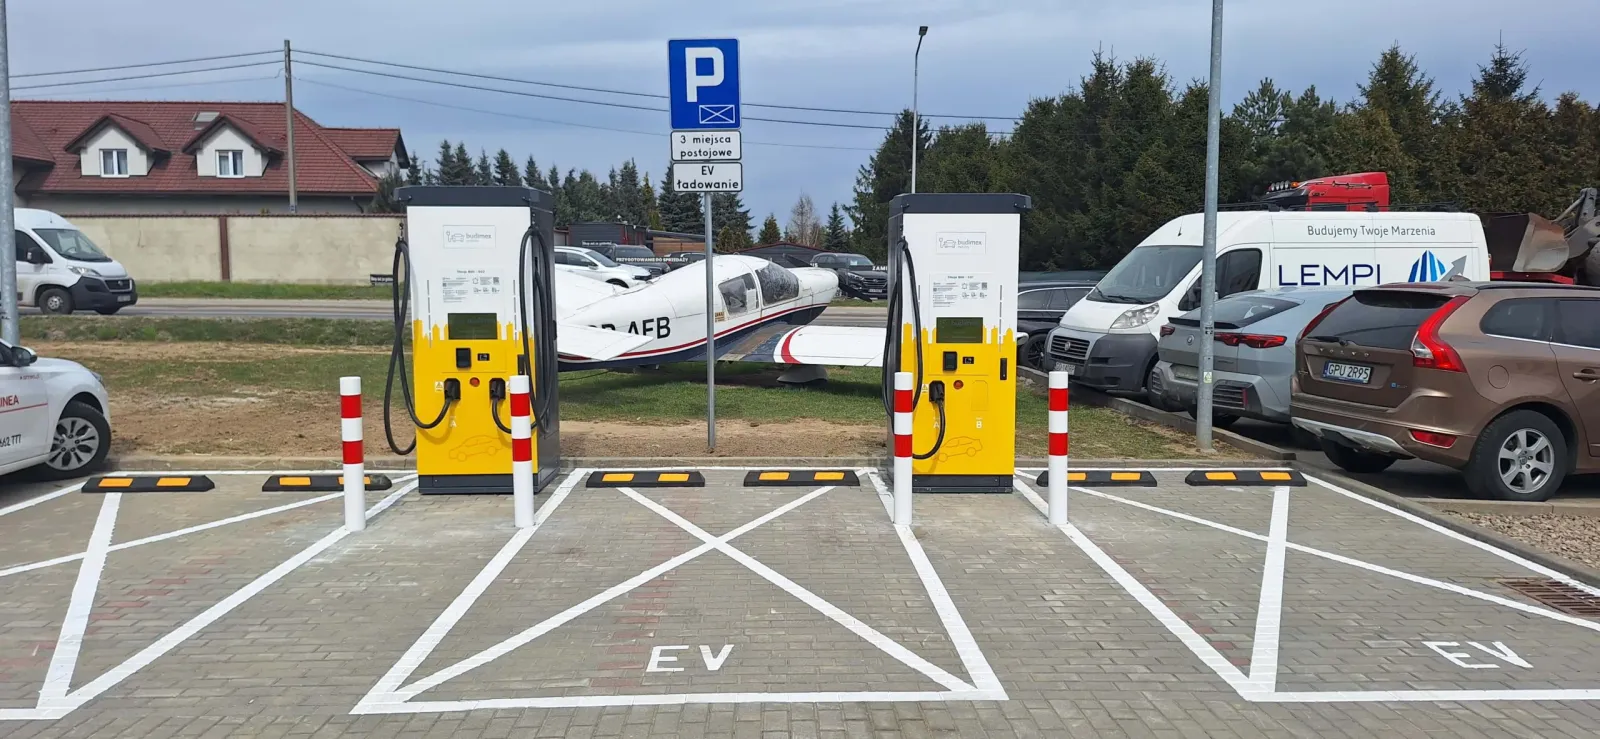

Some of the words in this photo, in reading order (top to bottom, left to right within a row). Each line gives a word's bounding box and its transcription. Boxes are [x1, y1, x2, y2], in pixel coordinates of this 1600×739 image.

[685, 46, 725, 103] P
[680, 135, 686, 144] 3
[692, 134, 731, 146] miejsca
[680, 148, 732, 160] postojowe
[701, 165, 715, 176] EV
[677, 179, 739, 189] ładowanie
[1307, 225, 1358, 239] Budujemy
[1360, 225, 1389, 238] Twoje
[1391, 225, 1436, 236] Marzenia
[1278, 263, 1381, 286] LEMPI
[1328, 363, 1346, 376] GPU
[1347, 365, 1370, 380] 2R95
[976, 420, 983, 429] B
[645, 644, 734, 673] EV
[1421, 641, 1535, 668] EV
